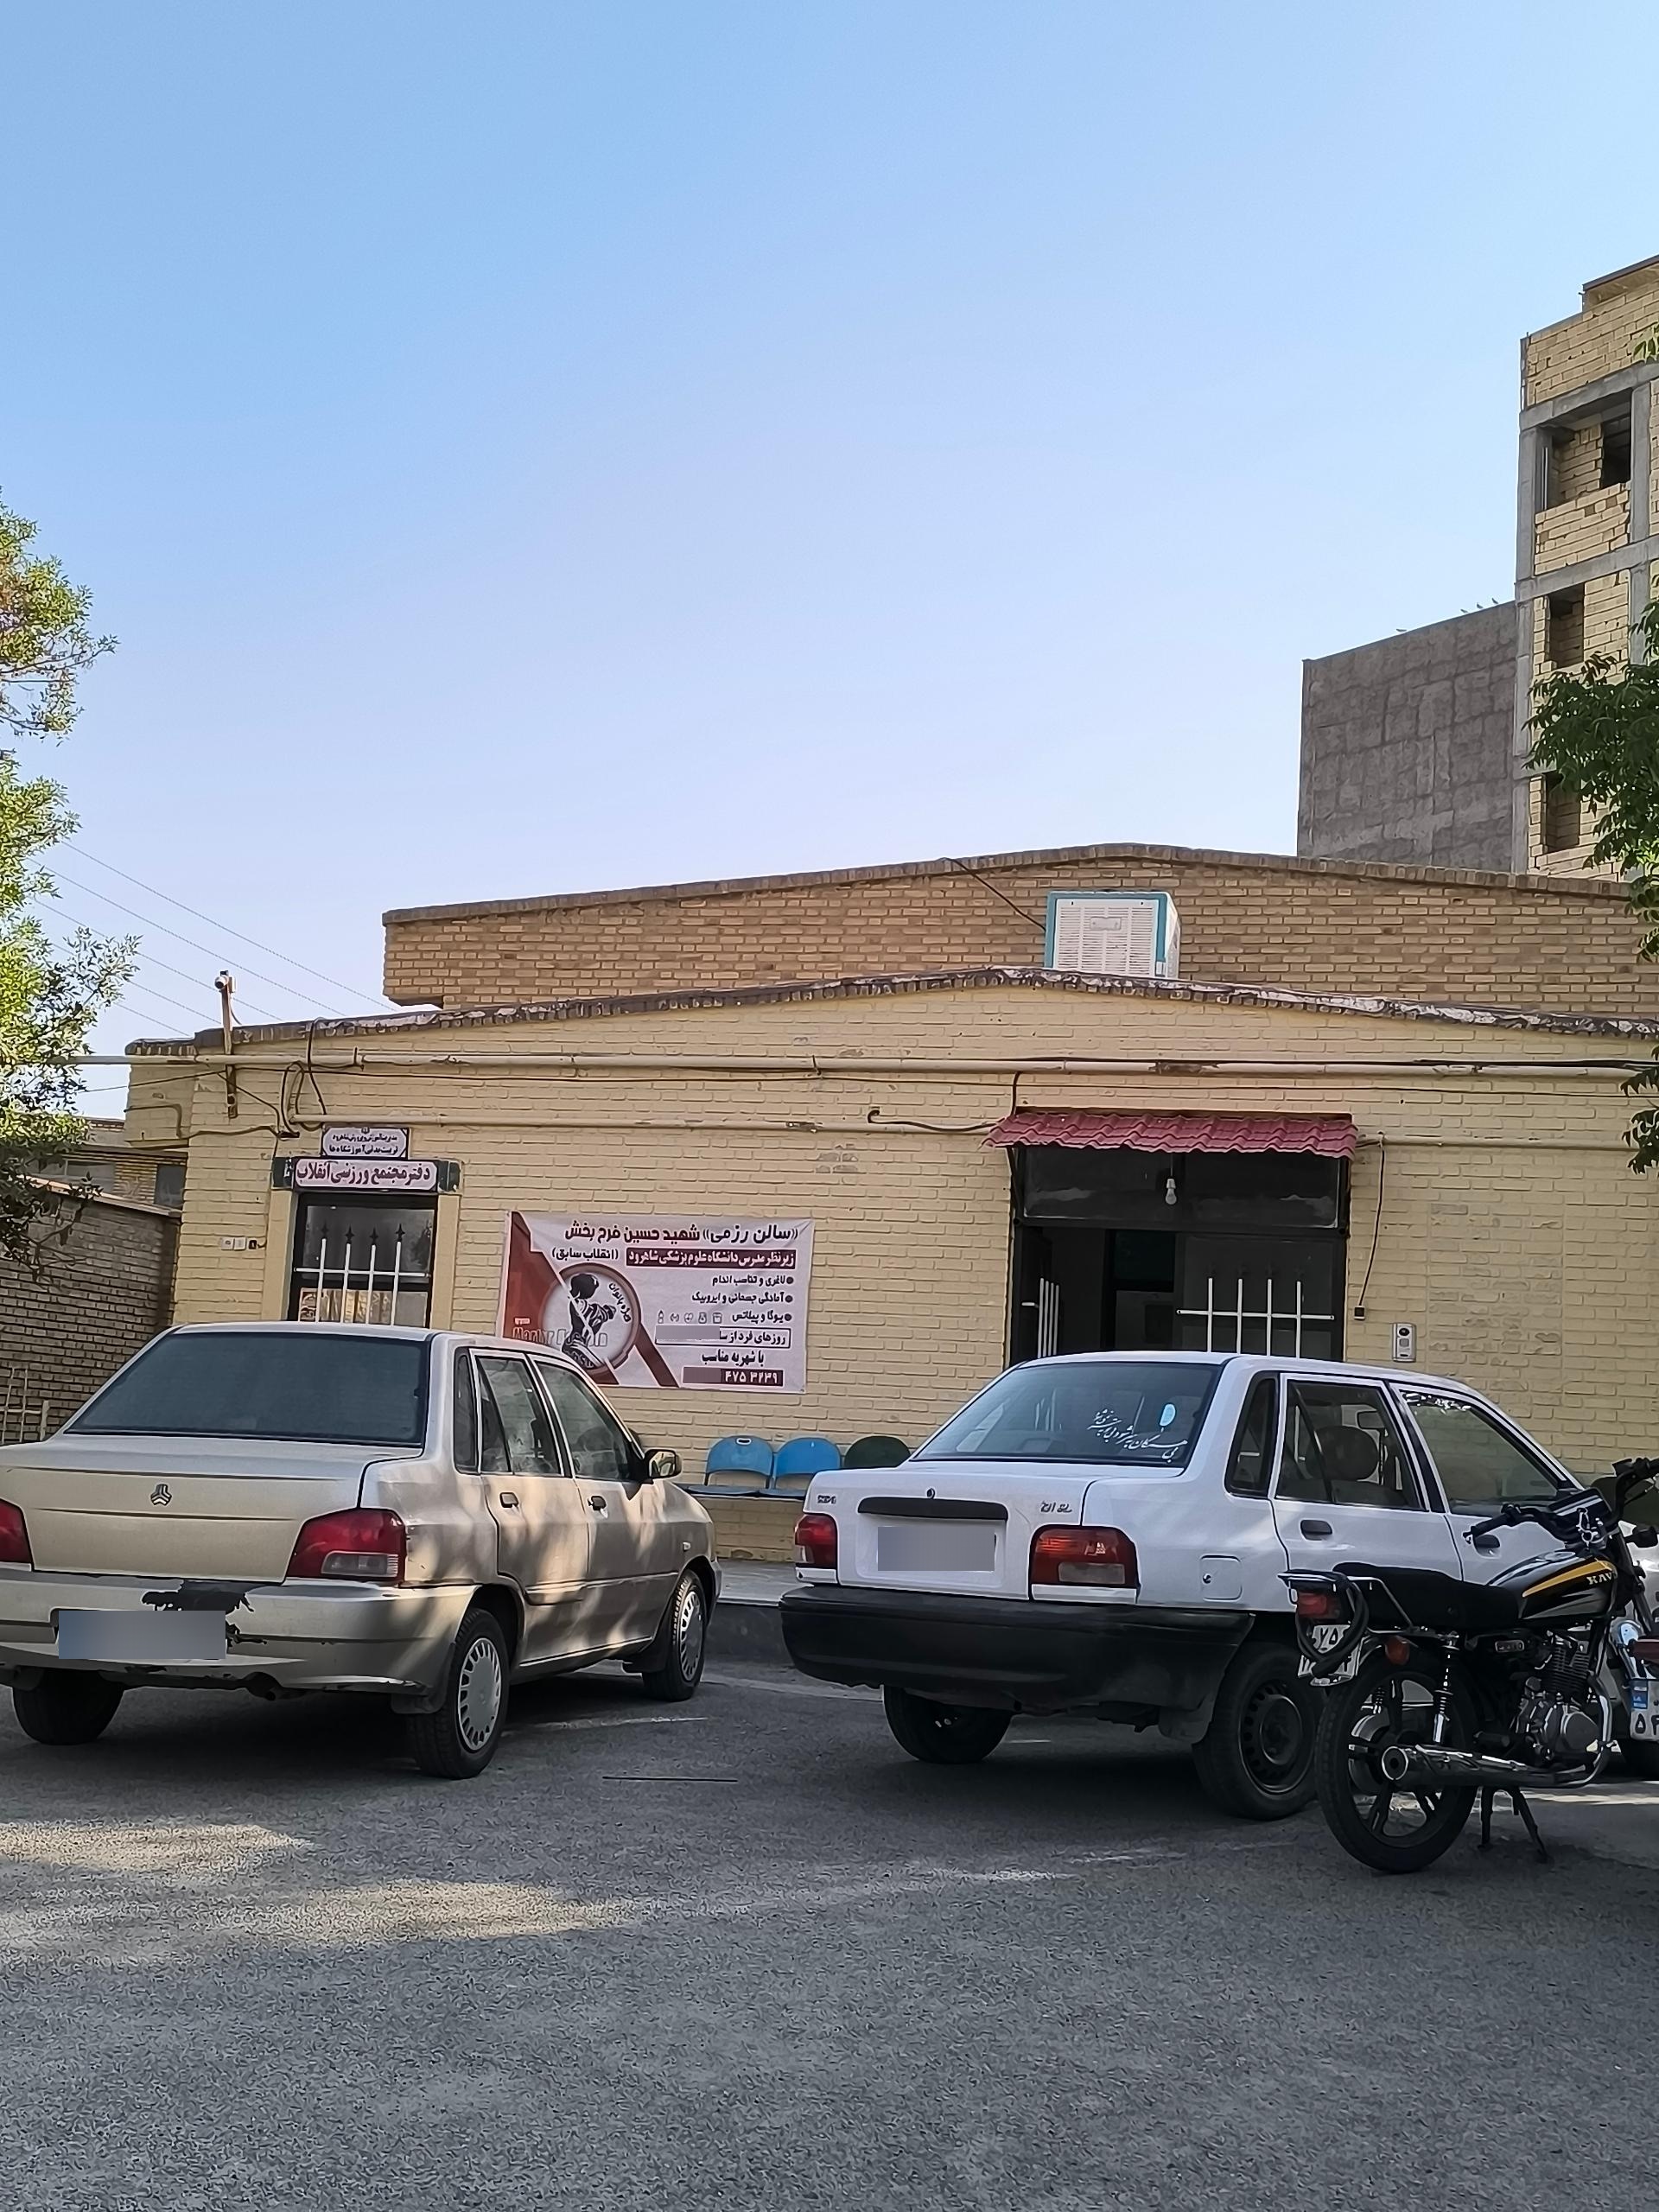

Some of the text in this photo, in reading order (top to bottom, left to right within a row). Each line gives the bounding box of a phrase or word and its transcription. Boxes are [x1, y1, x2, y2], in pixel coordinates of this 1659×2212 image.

[297, 1161, 332, 1184] انقلاب
[331, 1162, 369, 1184] ورزشی
[371, 1166, 406, 1185] مجتمع
[405, 1163, 430, 1185] دفتر
[564, 1220, 594, 1241] بخش
[597, 1225, 620, 1243] فرح
[624, 1227, 660, 1243] حسین
[663, 1224, 700, 1245] شهید
[629, 1249, 794, 1267] زیر نظر مدرس دانشگاه علوم پزشکی شاهرود
[712, 1274, 785, 1287] لاغری و تناسب اندام
[721, 1295, 727, 1304] و
[728, 1293, 757, 1304] جسمانی
[759, 1292, 785, 1304] آمادگی
[733, 1310, 784, 1325] یوگا و پیلاتس
[738, 1330, 753, 1344] فرد
[753, 1332, 786, 1345] روزهای
[702, 1349, 765, 1367] با شهریه مناسب
